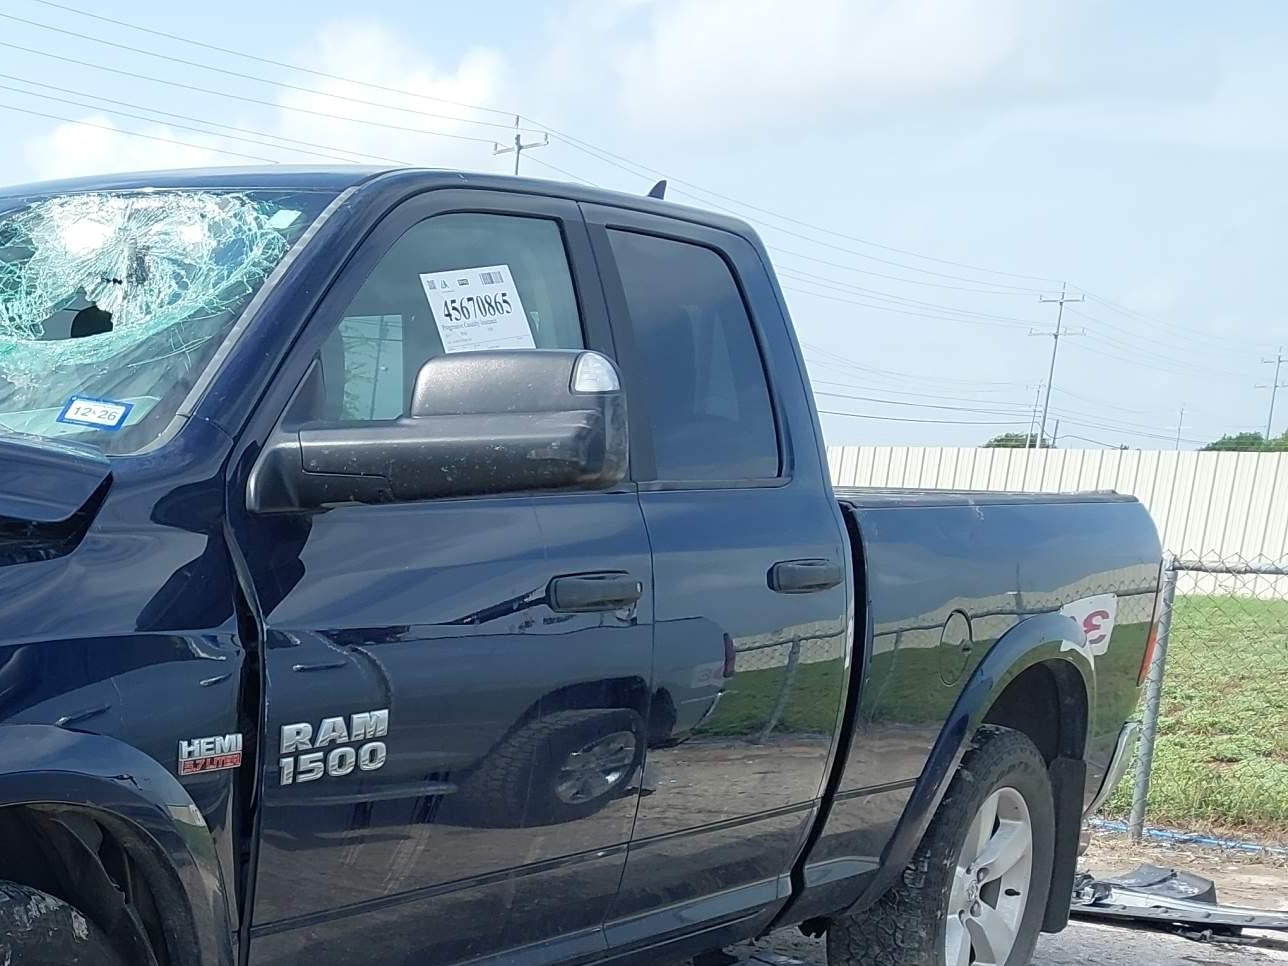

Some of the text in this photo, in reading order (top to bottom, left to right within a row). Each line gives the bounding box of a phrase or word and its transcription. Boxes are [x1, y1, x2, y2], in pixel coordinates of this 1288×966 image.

[443, 292, 513, 322] 45670865
[179, 733, 242, 758] HEMI
[281, 709, 389, 753] RAM
[280, 741, 386, 786] 1500
